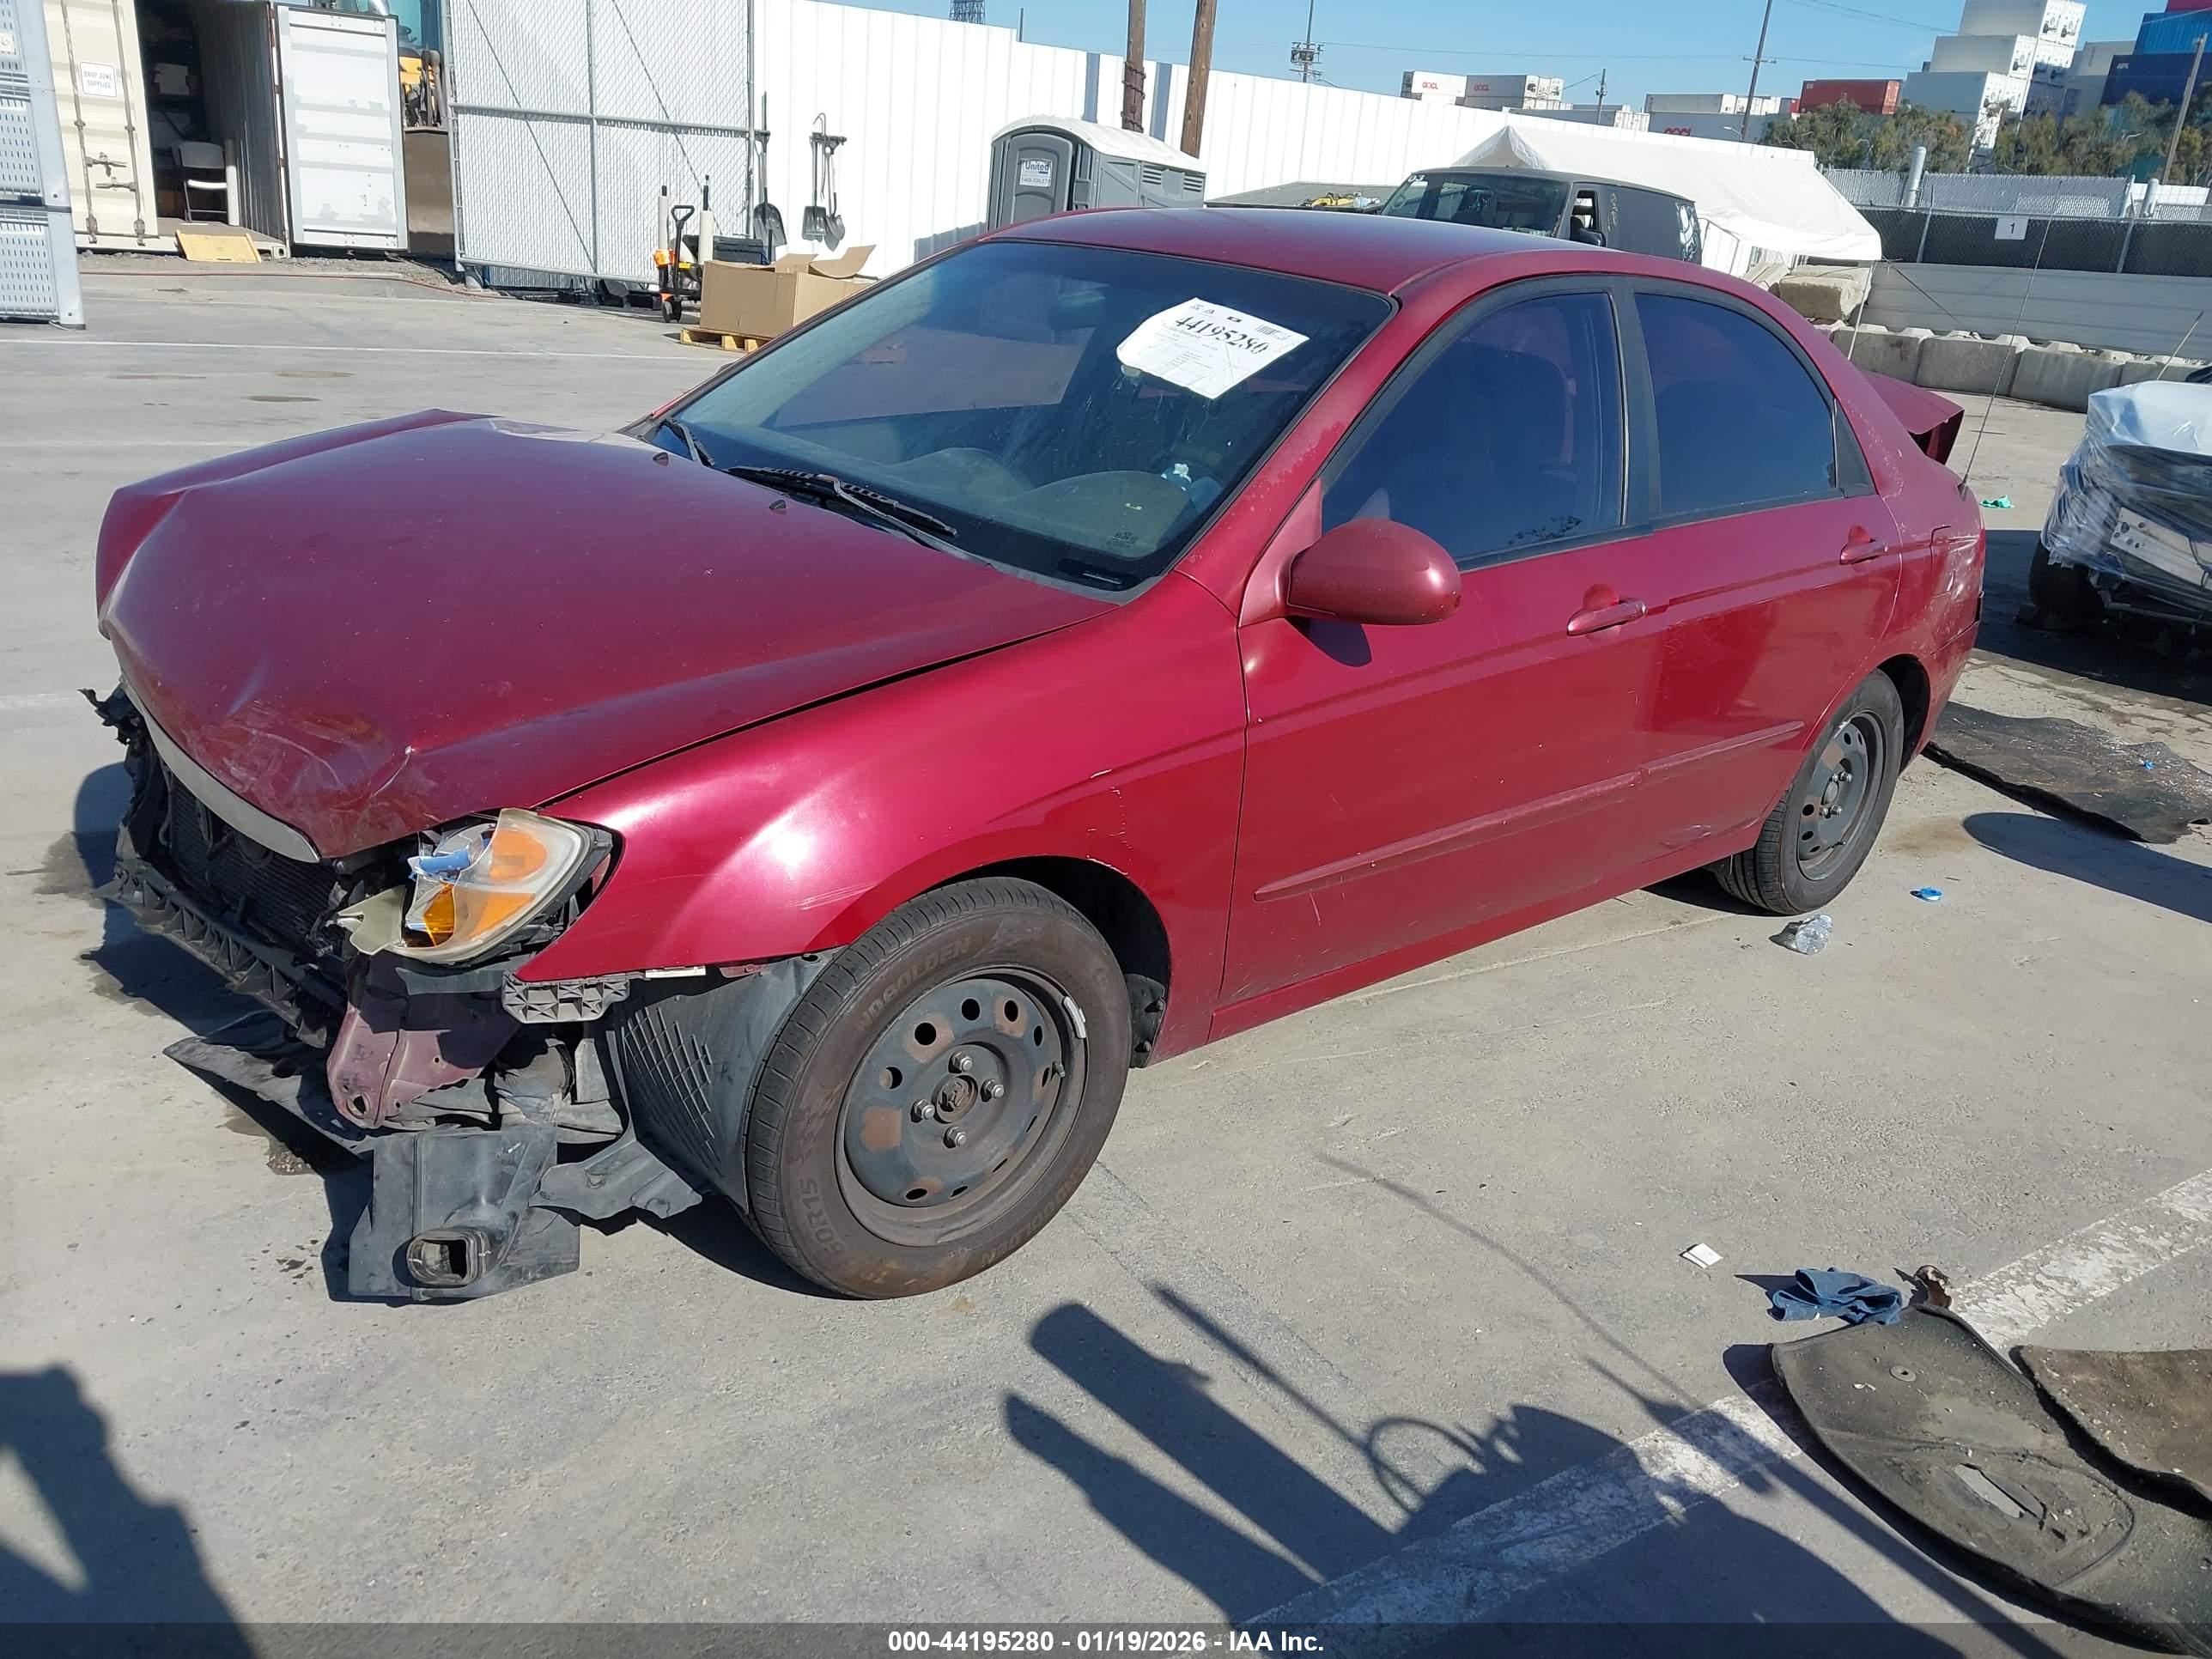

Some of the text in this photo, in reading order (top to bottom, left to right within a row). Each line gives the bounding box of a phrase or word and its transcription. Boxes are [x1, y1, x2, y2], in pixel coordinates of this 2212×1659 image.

[1025, 159, 1049, 171] United
[2008, 221, 2015, 234] 1
[1175, 315, 1270, 356] 44195280
